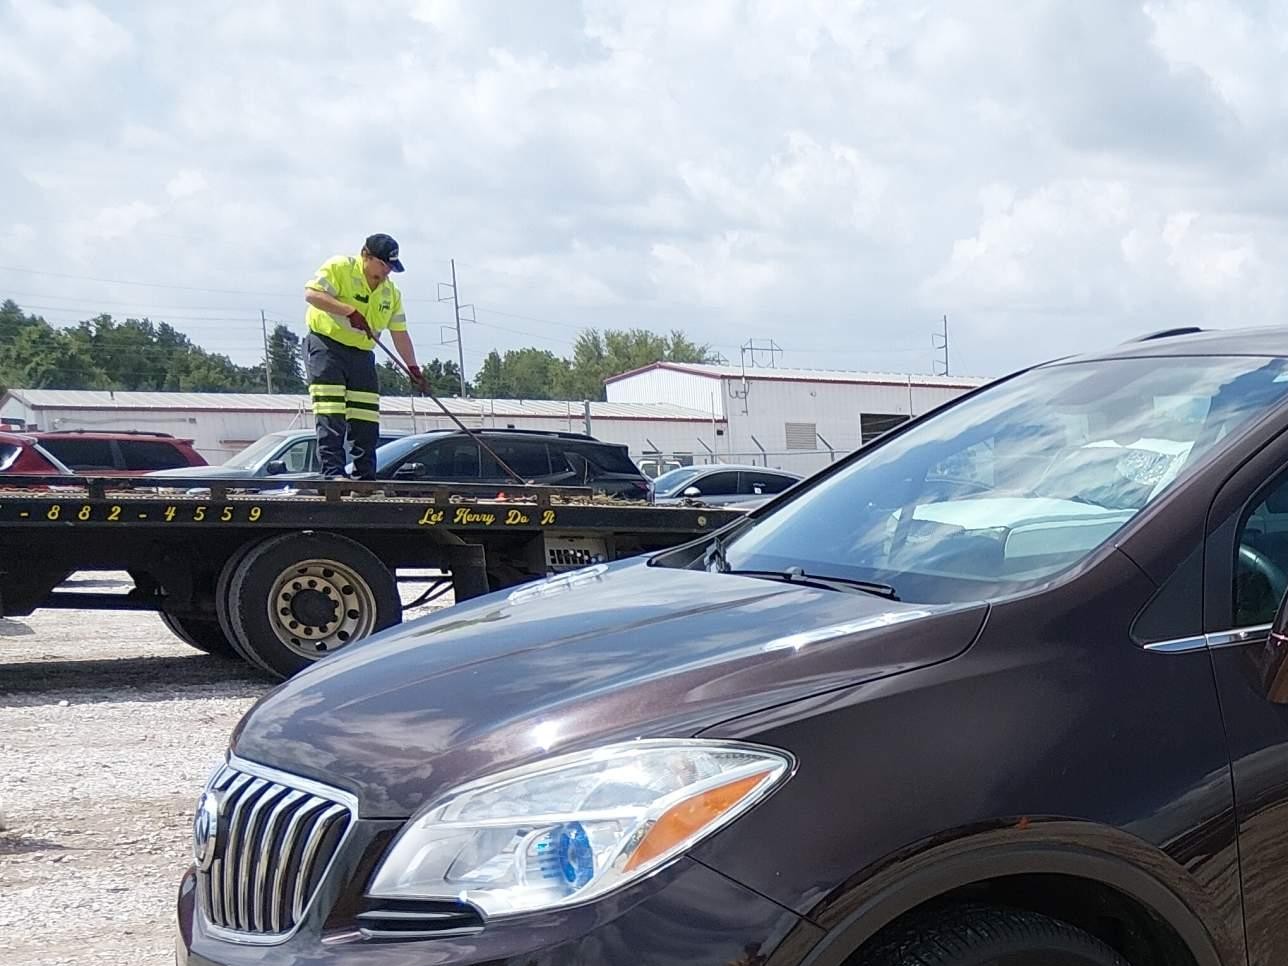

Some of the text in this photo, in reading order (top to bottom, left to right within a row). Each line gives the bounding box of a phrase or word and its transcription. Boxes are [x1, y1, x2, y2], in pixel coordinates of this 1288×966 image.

[0, 505, 262, 521] -882-4559
[418, 508, 555, 525] Let Henry Do It
